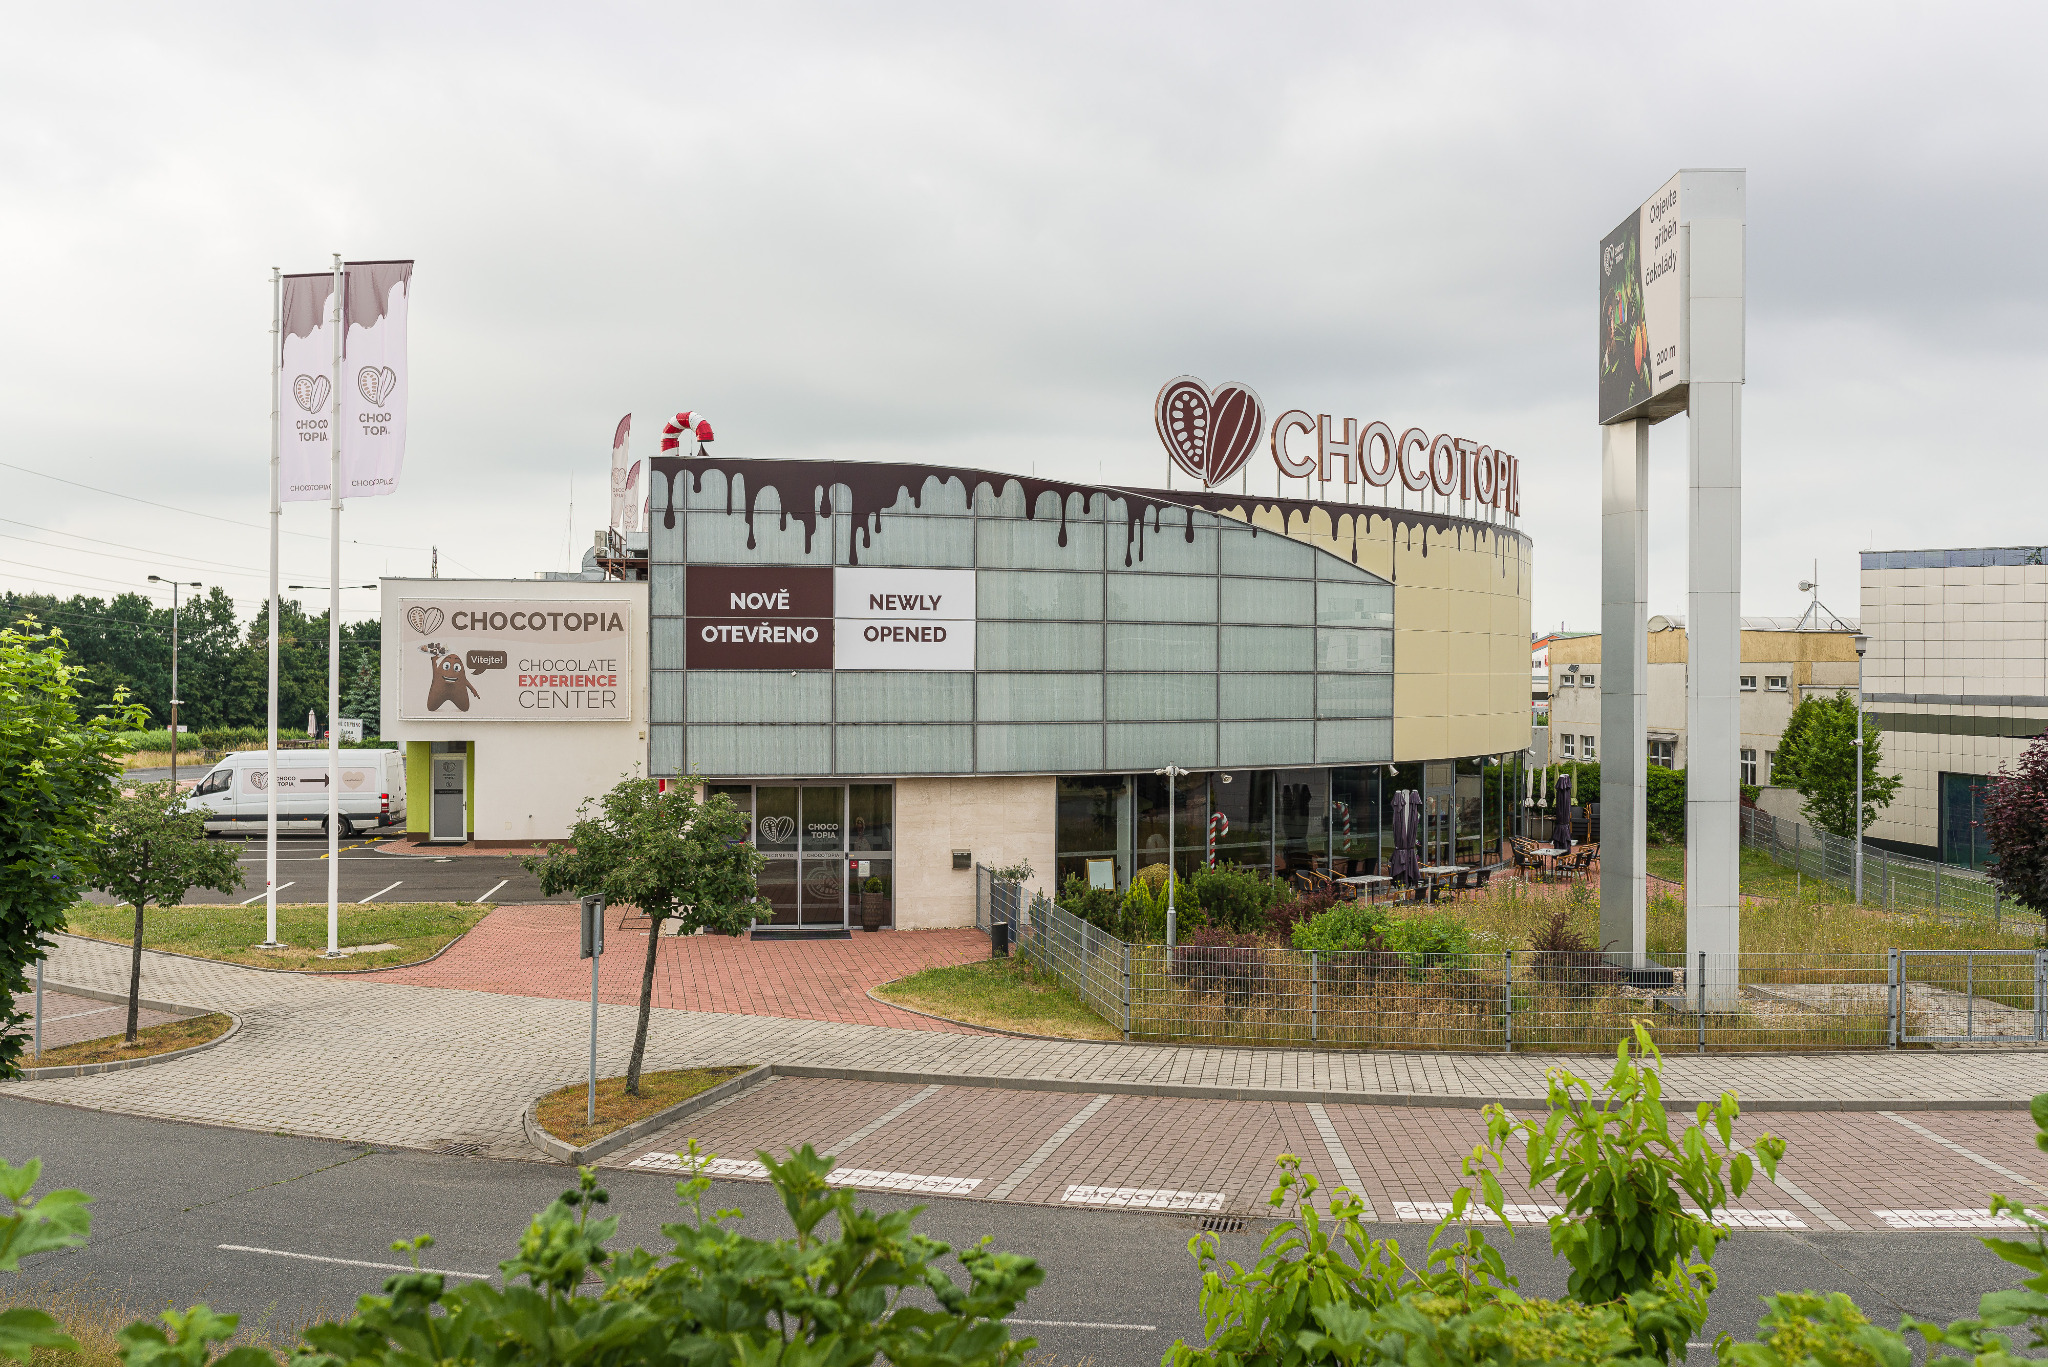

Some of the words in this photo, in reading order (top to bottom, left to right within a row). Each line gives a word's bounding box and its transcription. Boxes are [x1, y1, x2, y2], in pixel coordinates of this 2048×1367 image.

[1649, 189, 1677, 224] Objevte
[1654, 216, 1677, 255] příběh
[1645, 248, 1678, 287] čokolády
[1656, 347, 1668, 366] 200
[1669, 345, 1676, 358] m
[296, 419, 328, 430] CHOCO
[299, 432, 328, 442] TOPIA
[1271, 409, 1520, 517] CHOCOTOPIA
[730, 588, 790, 610] NOVĚ
[869, 593, 942, 611] NEWLY
[451, 610, 625, 632] CHOCOTOPIA
[701, 621, 819, 643] OTEVŘENO
[863, 625, 947, 643] OPENED
[518, 659, 617, 672] CHOCOLATE
[518, 674, 617, 687] EXPERIENCE
[518, 690, 617, 709] CENTER
[807, 823, 839, 831] CHOCO
[811, 831, 836, 839] TOPIA
